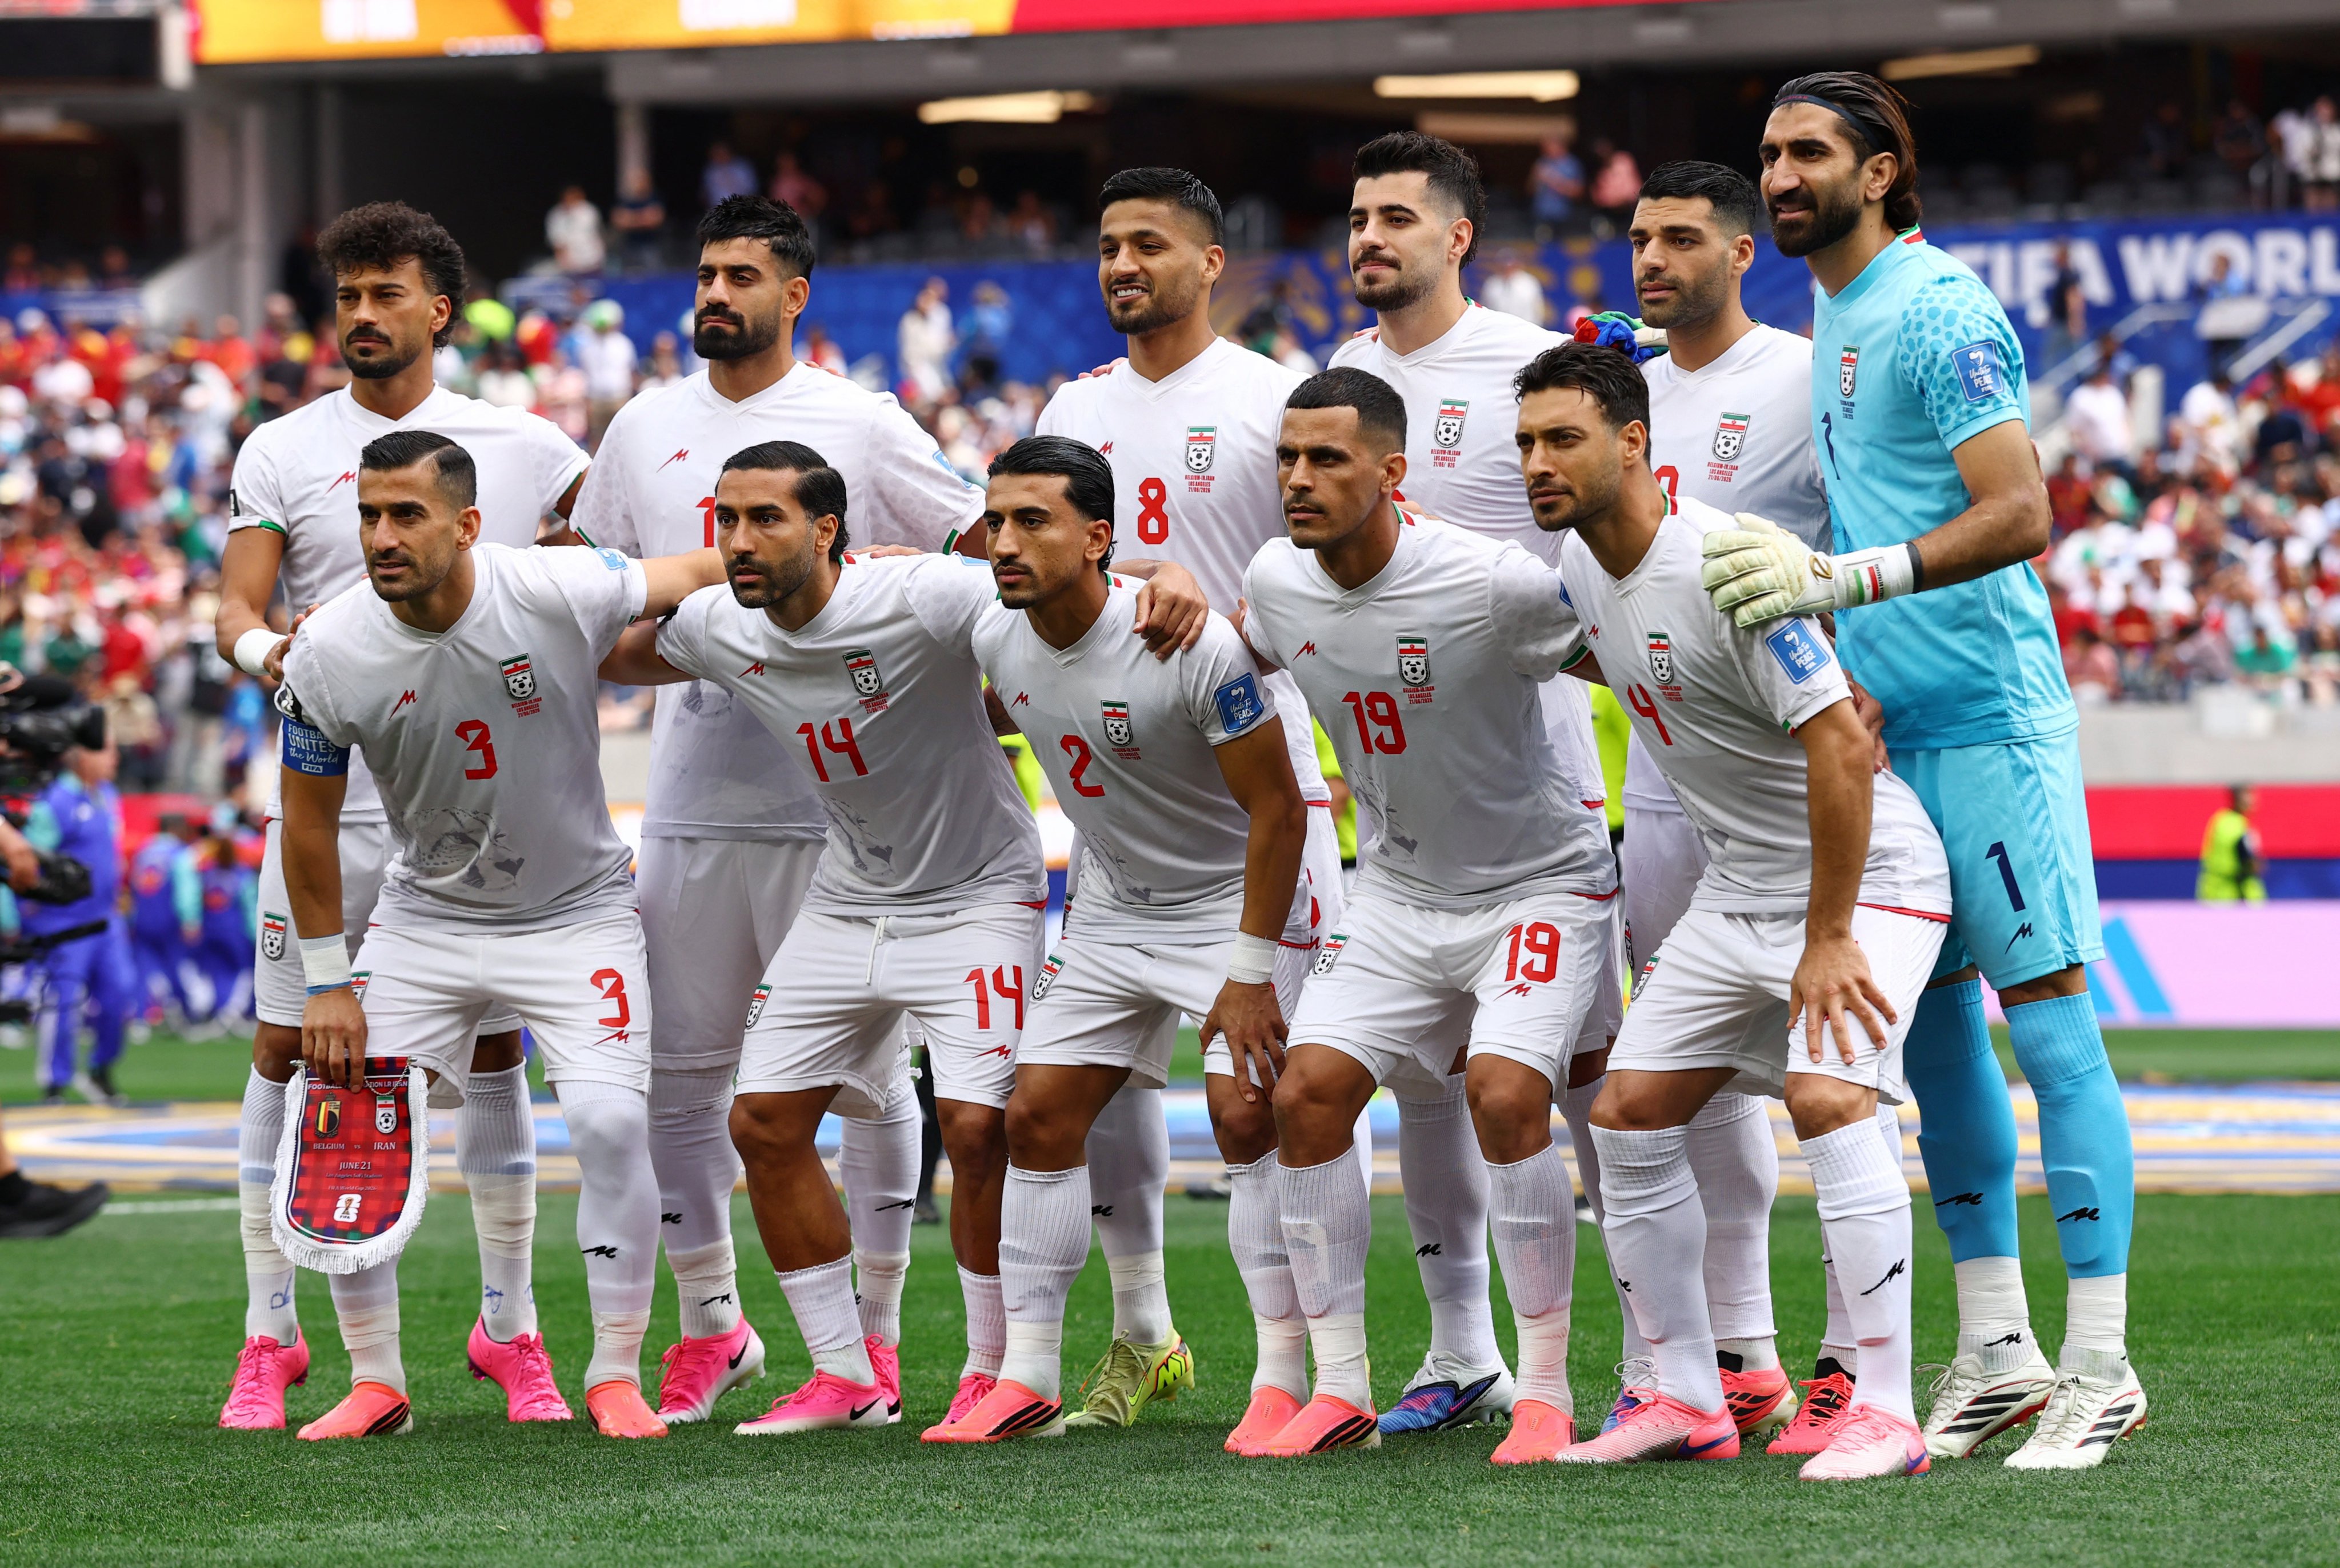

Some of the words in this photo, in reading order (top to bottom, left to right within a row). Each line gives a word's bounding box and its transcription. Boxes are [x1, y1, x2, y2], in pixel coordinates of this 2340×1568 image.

[1974, 374, 1994, 388] PEACE
[696, 497, 716, 548] 1
[1138, 478, 1169, 545] 8
[1795, 650, 1817, 668] PEACE
[288, 723, 329, 740] FOOTBA
[1233, 707, 1255, 720] PEACE
[1342, 692, 1407, 754] 19
[1628, 684, 1673, 745] 4
[288, 733, 337, 753] UNITES
[289, 747, 305, 759] the
[306, 751, 339, 764] World
[302, 763, 323, 773] FIFA
[455, 719, 498, 780] 3
[797, 718, 869, 782] 14
[1061, 734, 1105, 797] 2
[1985, 841, 2026, 913] 1
[1505, 921, 1561, 983] 19
[590, 967, 631, 1028] 3
[963, 965, 1023, 1031] 14
[339, 1162, 359, 1170] JUNE
[361, 1161, 371, 1170] 21
[374, 1142, 396, 1150] IRAN
